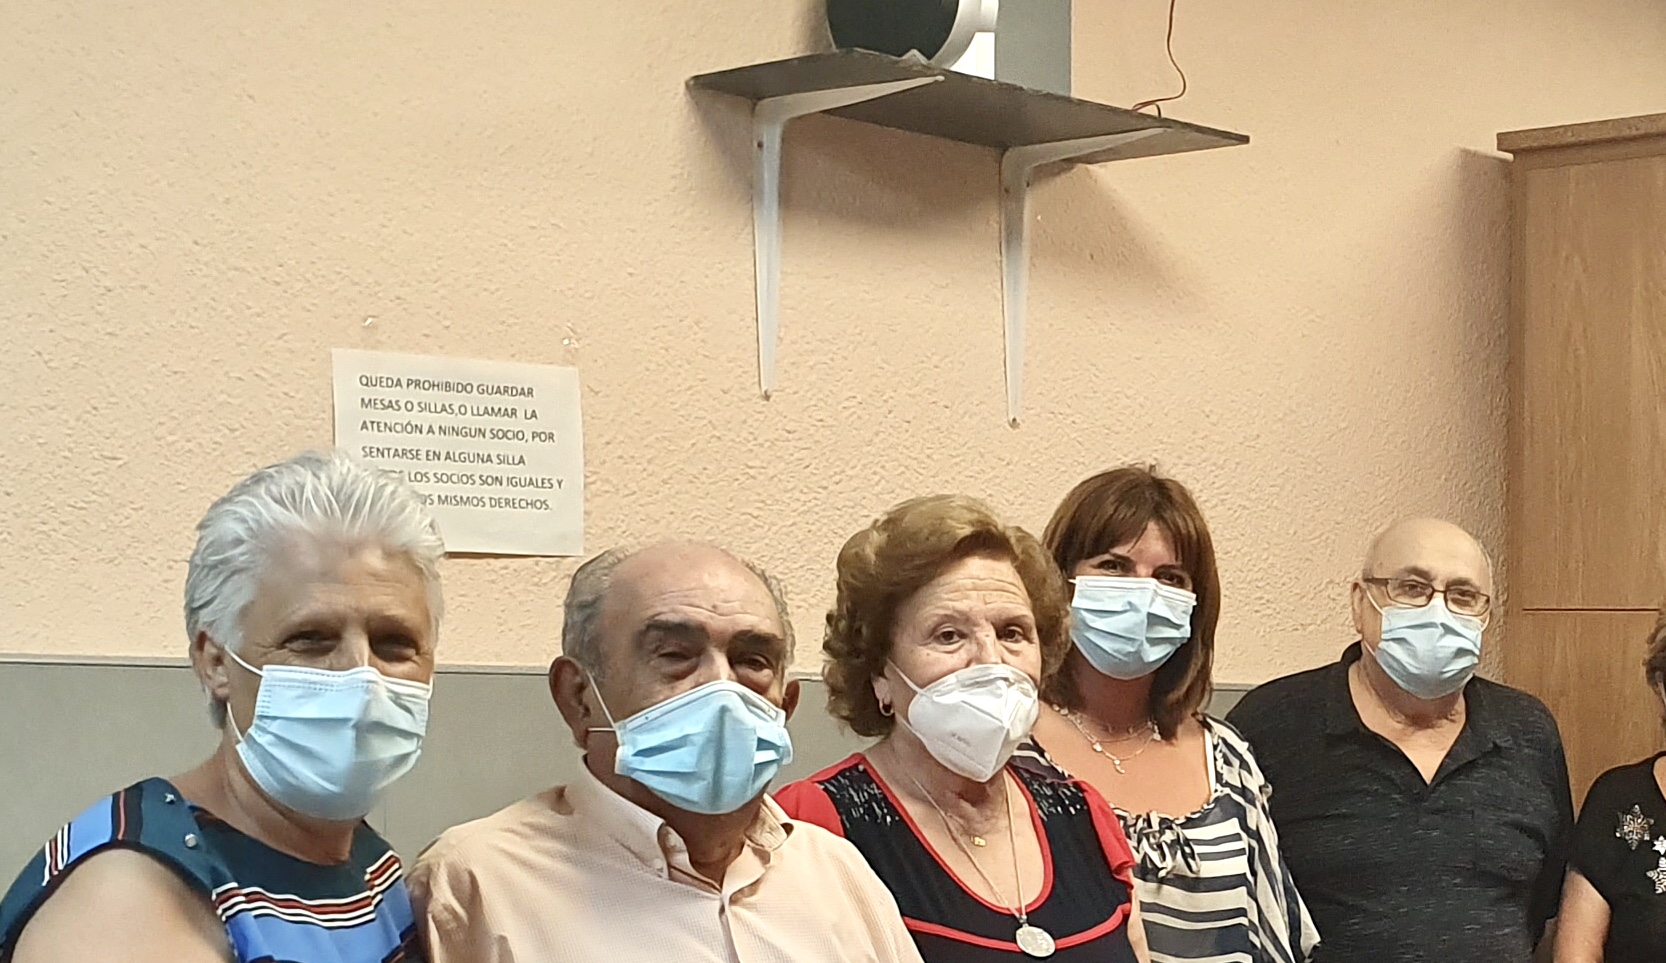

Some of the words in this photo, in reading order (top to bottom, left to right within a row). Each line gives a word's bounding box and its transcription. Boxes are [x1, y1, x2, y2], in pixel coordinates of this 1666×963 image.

[358, 374, 403, 390] QUEDA
[406, 377, 474, 395] PROHIBIDO
[476, 383, 535, 399] GUARDAR
[360, 397, 401, 412] MESAS
[404, 400, 415, 413] O
[470, 404, 518, 419] LLAMAR
[523, 408, 538, 421] LA
[360, 419, 423, 436] ATENCIÓN
[426, 423, 436, 436] A
[438, 425, 486, 439] NINGUN
[489, 429, 529, 443] SOCIO,
[531, 431, 555, 443] POR
[361, 446, 422, 461] SENTARSE
[425, 449, 441, 462] EN
[444, 451, 494, 465] ALGUNA
[496, 453, 526, 466] SILLA
[407, 471, 431, 484] LOS
[433, 472, 476, 486] SOCIOS
[478, 474, 503, 487] SON
[506, 475, 554, 489] IGUALES
[556, 478, 564, 490] Y
[420, 494, 434, 506] OS
[437, 493, 486, 508] MISMOS
[489, 496, 552, 511] DERECHOS.
